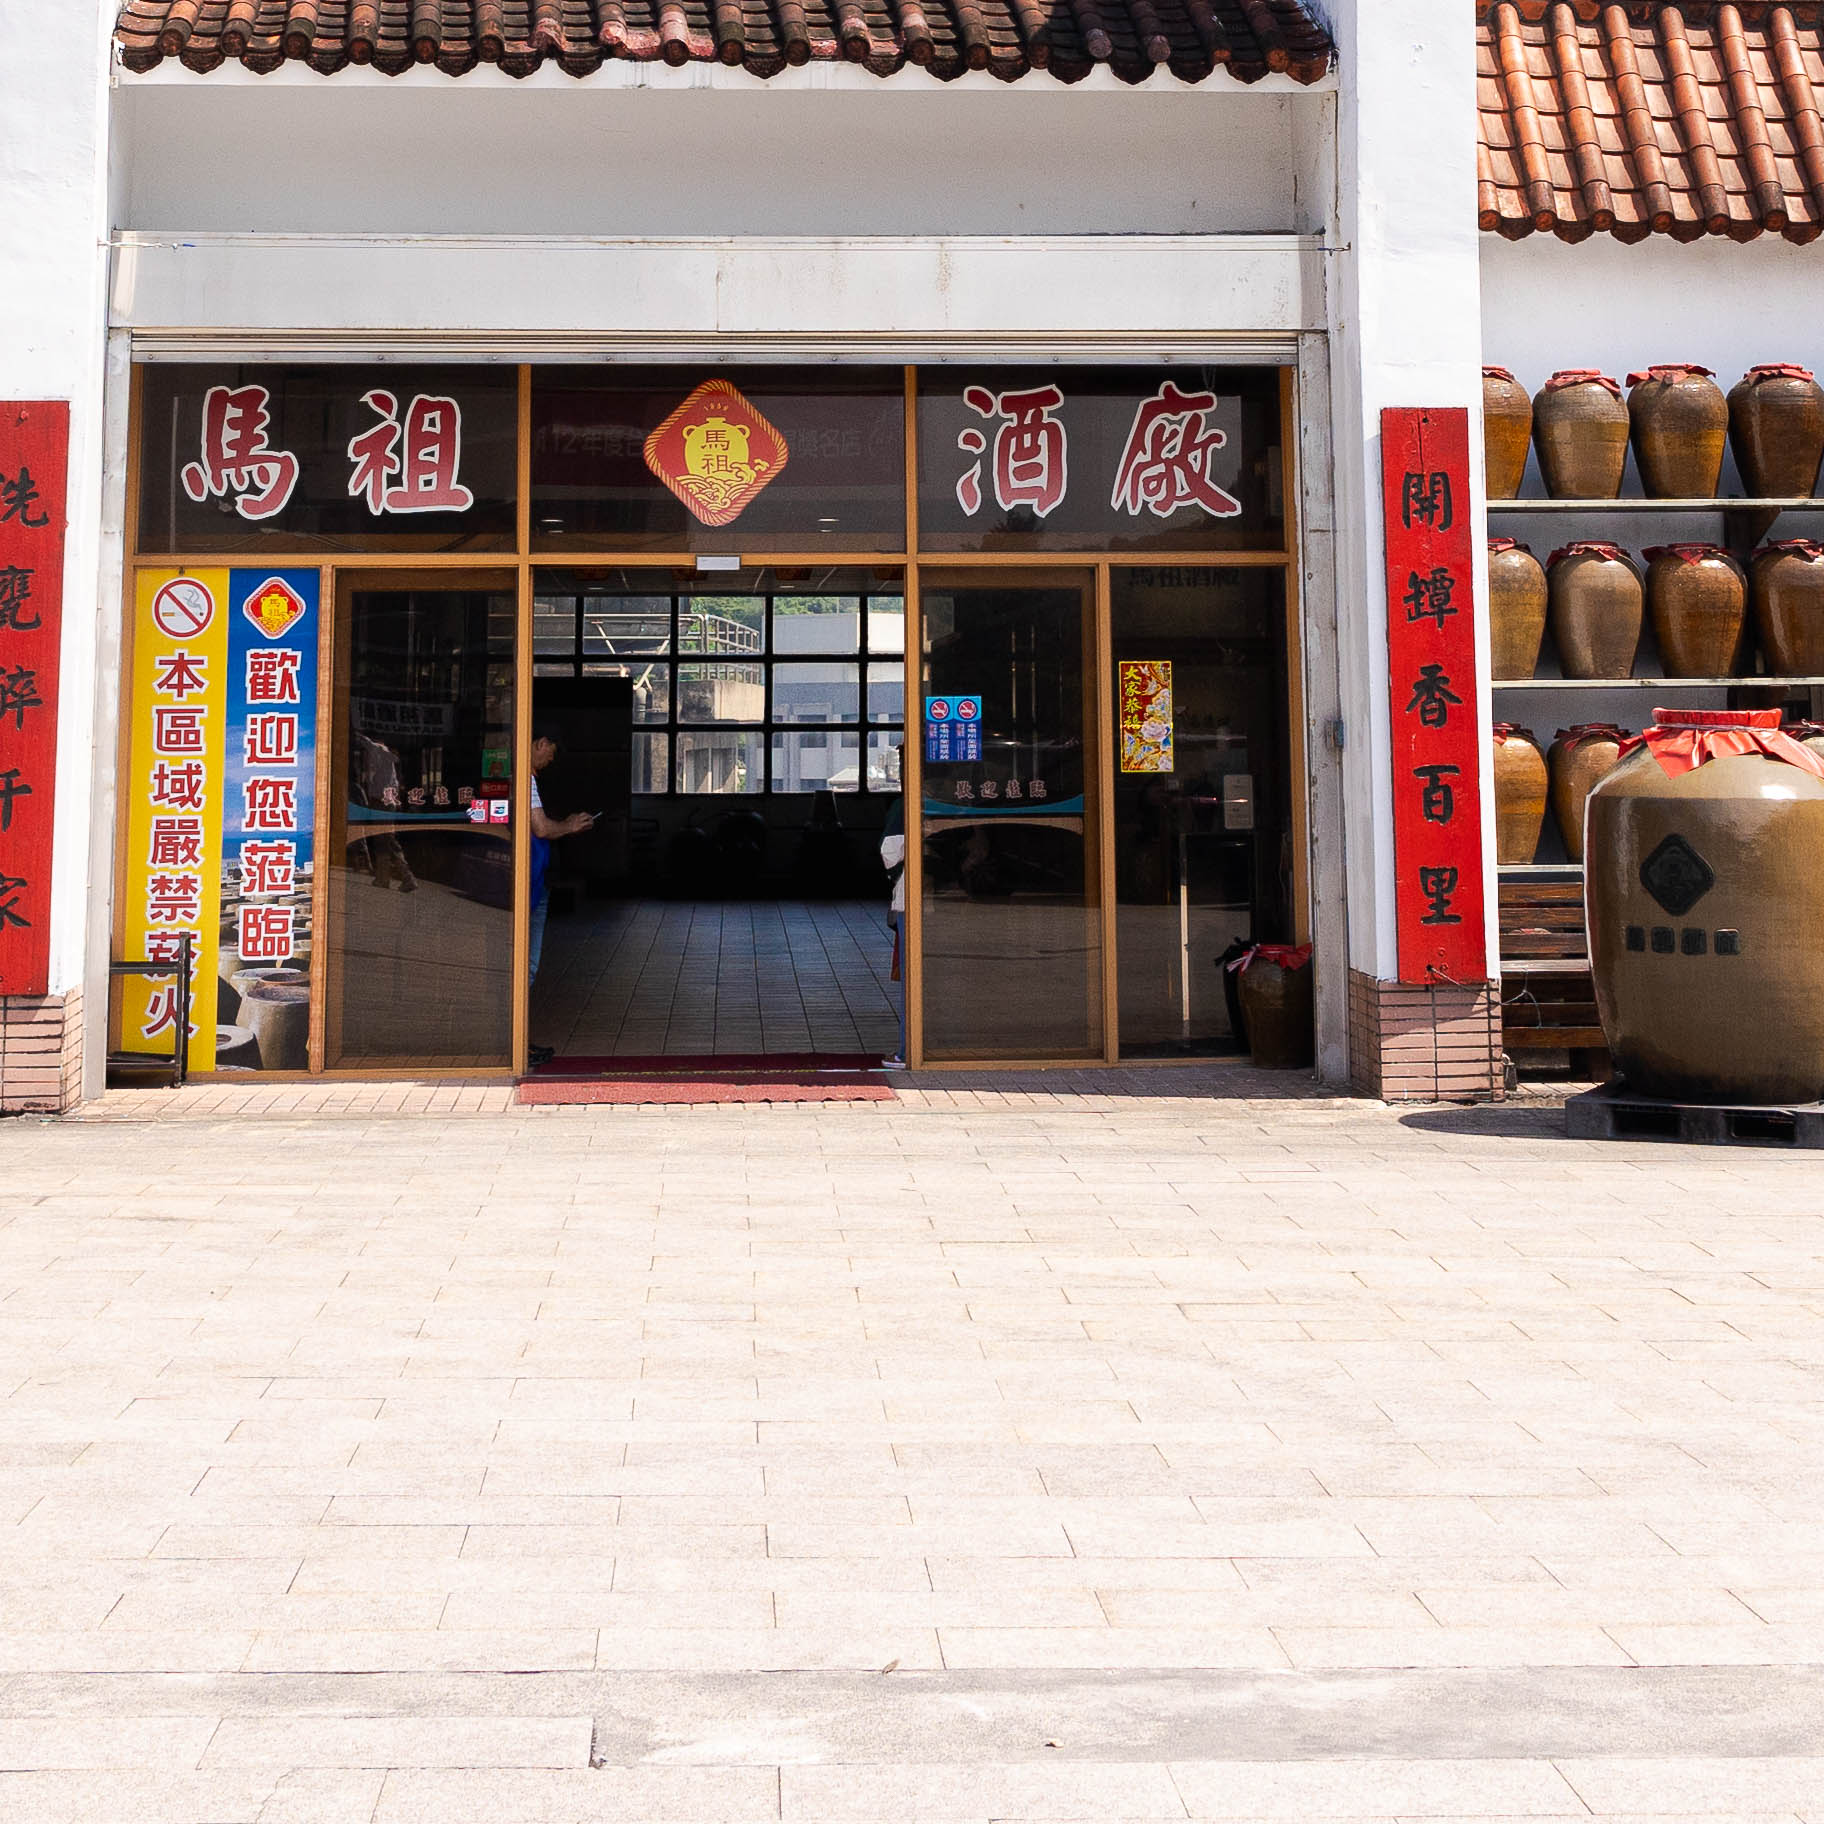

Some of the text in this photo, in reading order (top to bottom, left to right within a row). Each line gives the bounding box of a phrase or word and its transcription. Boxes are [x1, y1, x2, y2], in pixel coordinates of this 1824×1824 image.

[181, 385, 474, 520] 馬祖
[700, 428, 734, 475] 馬祖
[238, 648, 302, 962] 歡迎您蒞臨
